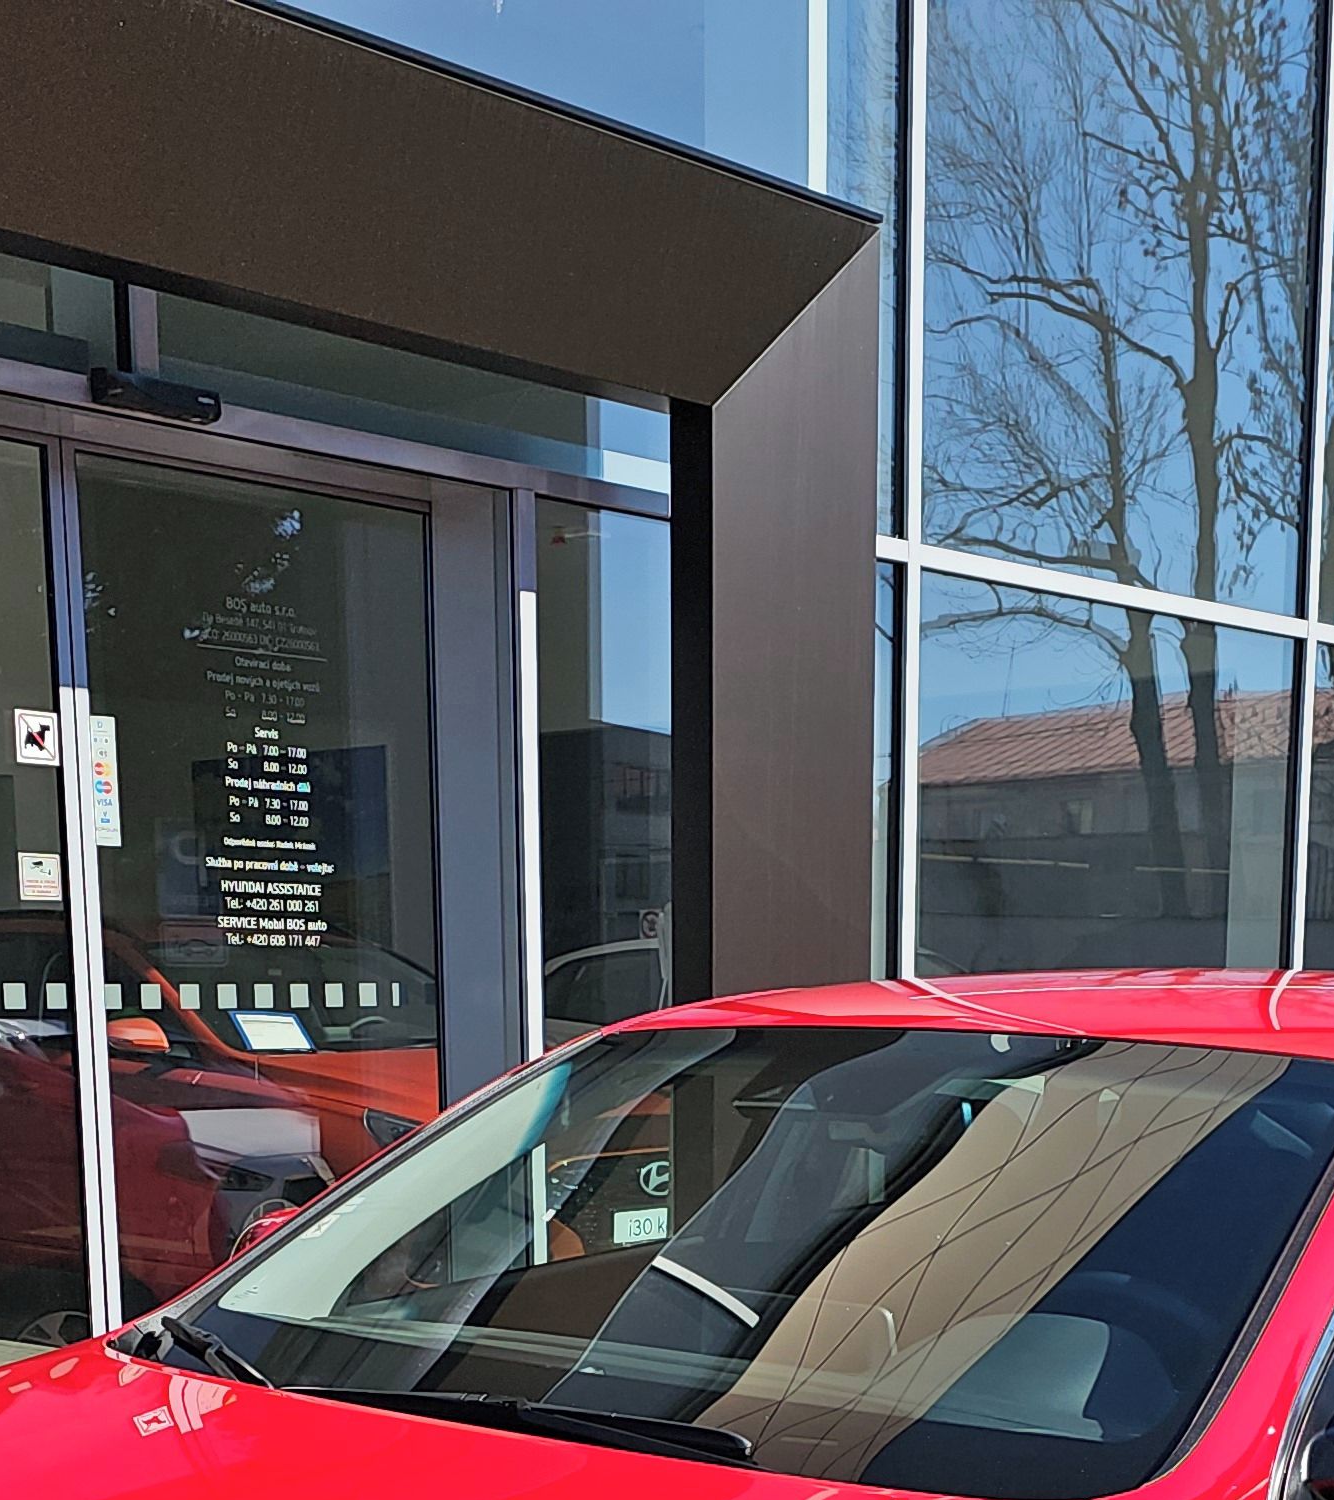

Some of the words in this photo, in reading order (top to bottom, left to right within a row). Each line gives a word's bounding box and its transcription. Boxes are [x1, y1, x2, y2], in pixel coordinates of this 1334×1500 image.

[251, 602, 271, 614] auto
[275, 606, 297, 618] s.r.o.
[207, 671, 234, 685] Prodej
[225, 690, 236, 700] Po
[255, 727, 279, 740] Servis
[227, 742, 237, 753] Po
[246, 743, 257, 755] Pá
[263, 745, 279, 756] 7.00
[288, 747, 307, 759] 17.00
[228, 758, 238, 769] So
[263, 761, 279, 773] 8.00
[288, 763, 307, 775] 12.00
[225, 776, 251, 790] Prodej
[97, 799, 113, 807] VISA
[229, 796, 240, 806] Po
[248, 797, 259, 808] Pá
[265, 798, 281, 810] 7.30
[290, 800, 309, 811] 17.00
[229, 812, 240, 822] So
[265, 814, 281, 826] 8.00
[290, 816, 309, 828] 12.00
[205, 856, 232, 868] Služba
[233, 861, 243, 870] po
[245, 860, 278, 871] pracovní
[280, 861, 298, 872] době
[220, 880, 264, 894] HYUNDAI
[267, 882, 322, 896] ASSISTANCE
[225, 897, 243, 909] Tel.:
[245, 898, 267, 910] +420
[269, 899, 284, 911] 261
[287, 900, 302, 912] 000
[305, 900, 319, 912] 261
[217, 916, 257, 929] SERVICE
[259, 917, 285, 929] Mobil
[287, 918, 305, 930] BOS
[307, 920, 327, 931] auto
[225, 933, 244, 945] Tel.:
[247, 934, 267, 946] +420
[270, 934, 286, 946] 608
[288, 935, 302, 946] 171
[305, 936, 321, 947] 447
[628, 1216, 652, 1238] i30
